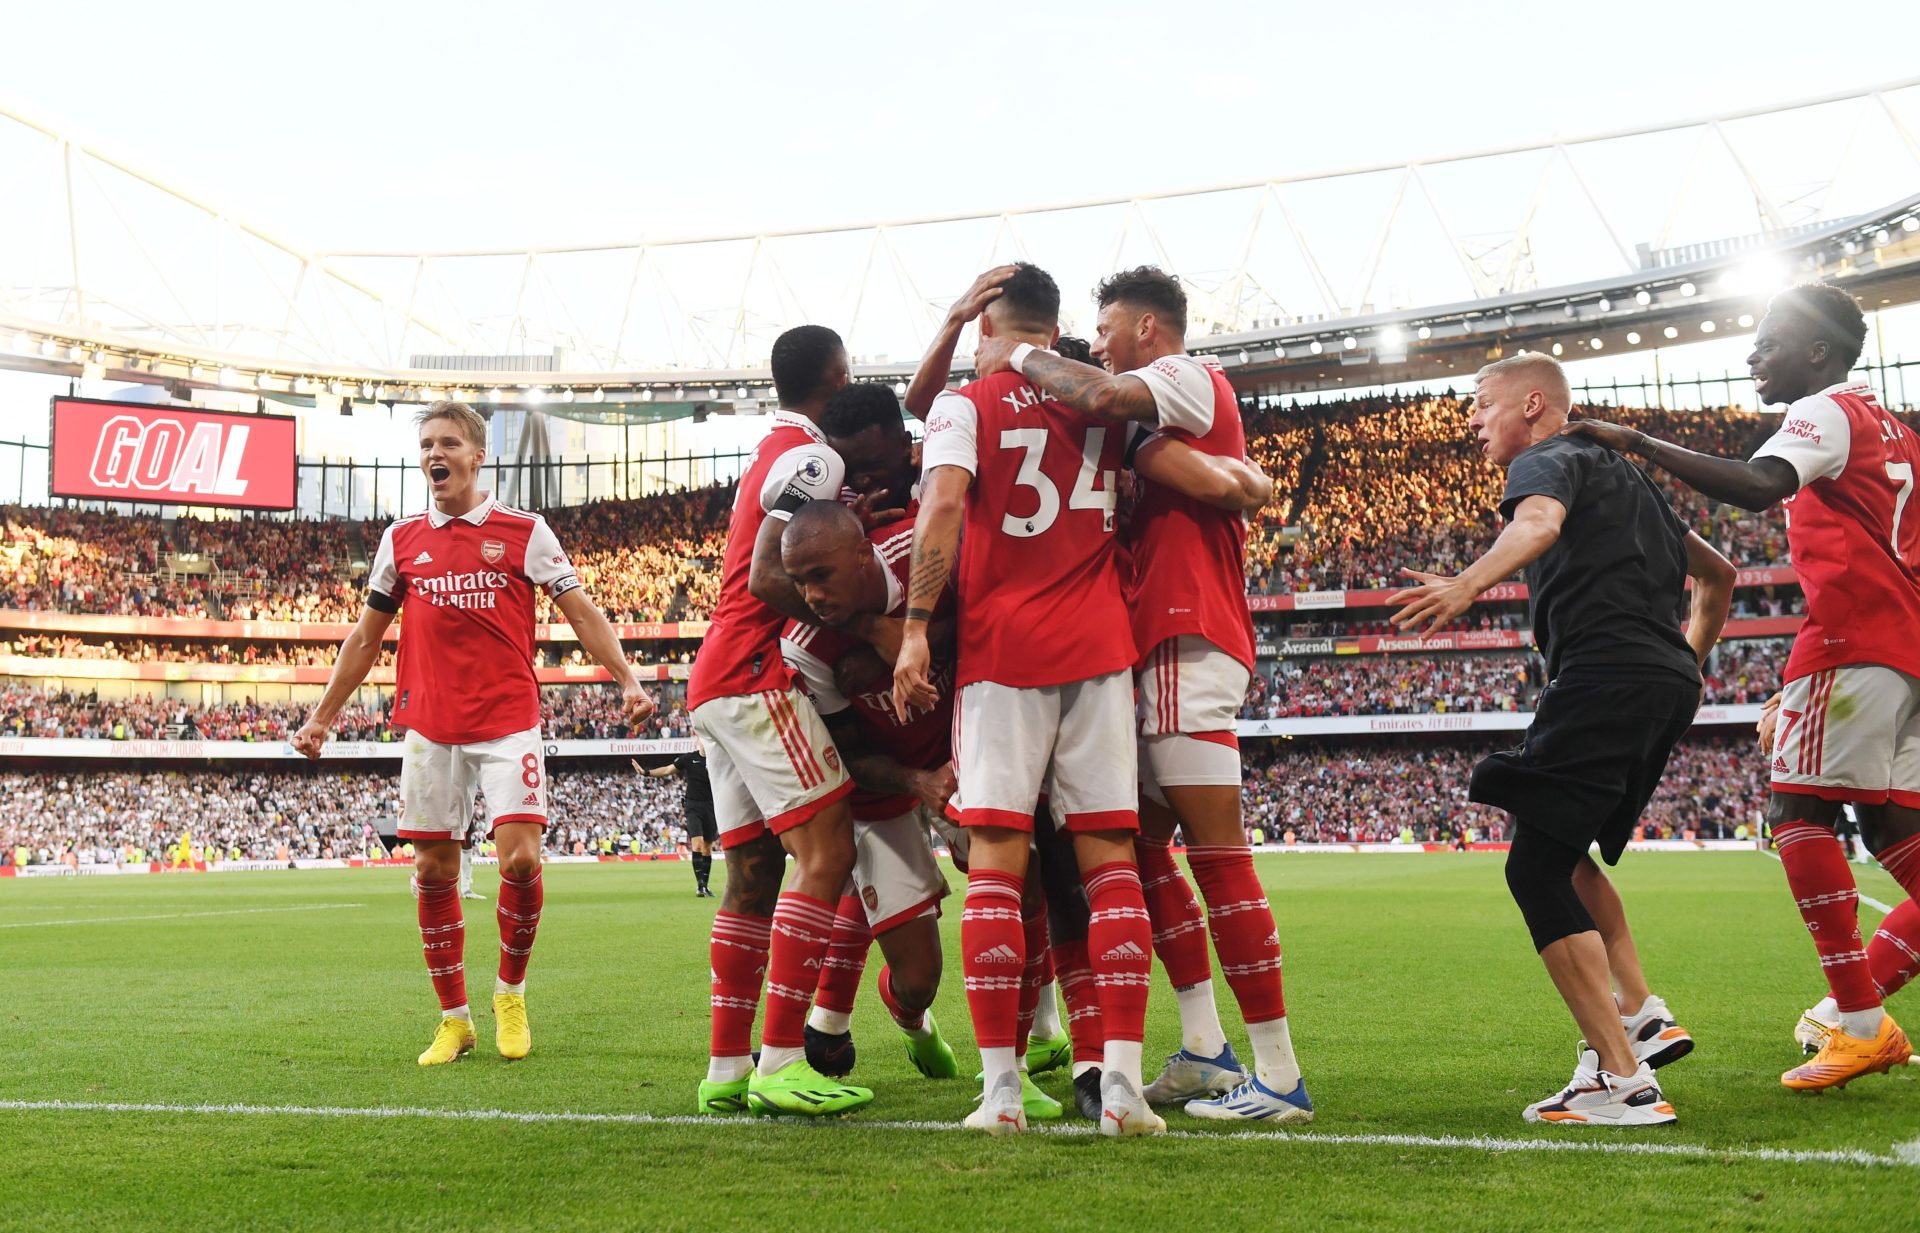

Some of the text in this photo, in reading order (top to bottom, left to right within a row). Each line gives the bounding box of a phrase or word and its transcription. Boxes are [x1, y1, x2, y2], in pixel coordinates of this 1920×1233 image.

[1788, 419, 1817, 433] VISIT
[89, 415, 250, 496] GOAL
[1000, 428, 1117, 537] 34
[1884, 461, 1914, 559] 7
[412, 569, 508, 596] Emirates
[1738, 572, 1772, 584] 1936
[1483, 587, 1516, 600] 1935
[632, 627, 661, 637] 1930
[1377, 638, 1453, 651] Arsenal.com
[1370, 719, 1424, 730] Emirates
[1777, 709, 1802, 752] 7
[610, 743, 657, 753] Emirates
[522, 753, 540, 788] 8
[974, 955, 1023, 964] adidas
[1101, 952, 1149, 961] adidas
